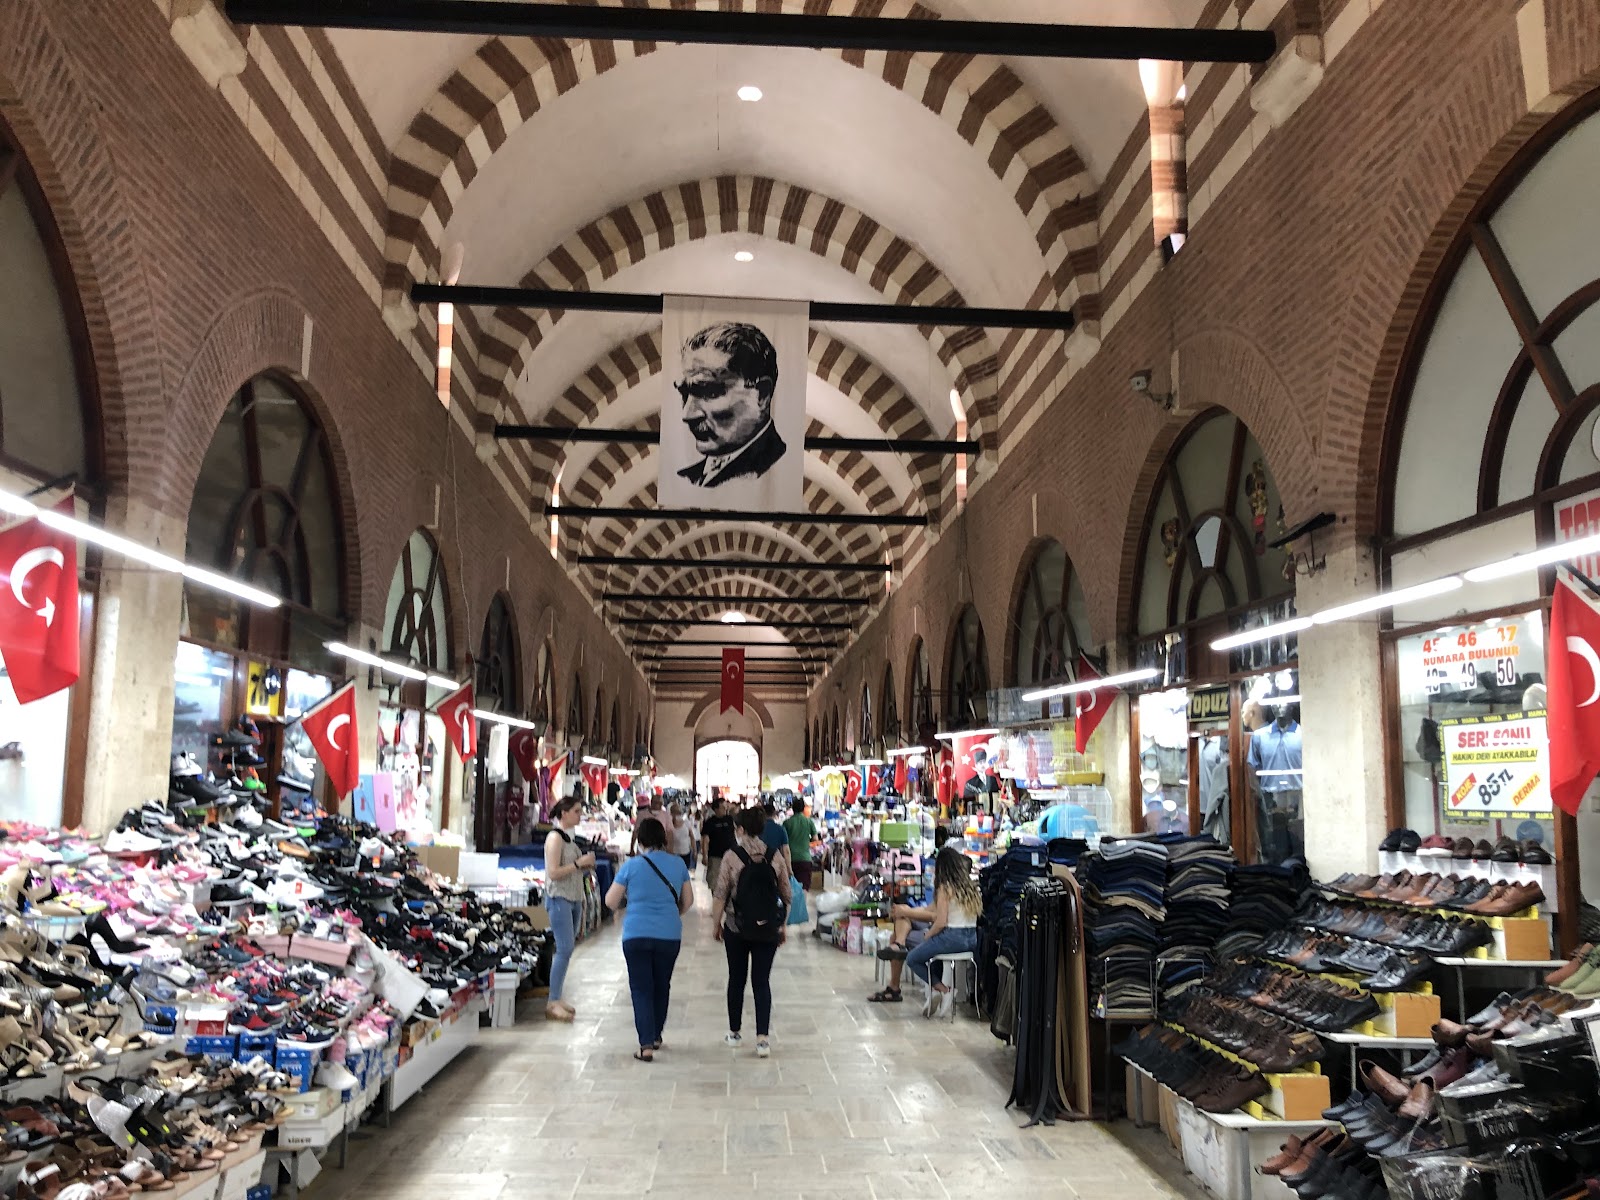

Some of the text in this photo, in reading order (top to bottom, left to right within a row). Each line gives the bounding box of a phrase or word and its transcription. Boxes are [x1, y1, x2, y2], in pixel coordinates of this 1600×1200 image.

[1457, 631, 1477, 647] 46
[1423, 645, 1520, 666] NUMARA BULUNUR
[1497, 657, 1514, 684] 50
[1512, 775, 1540, 806] DERMA
